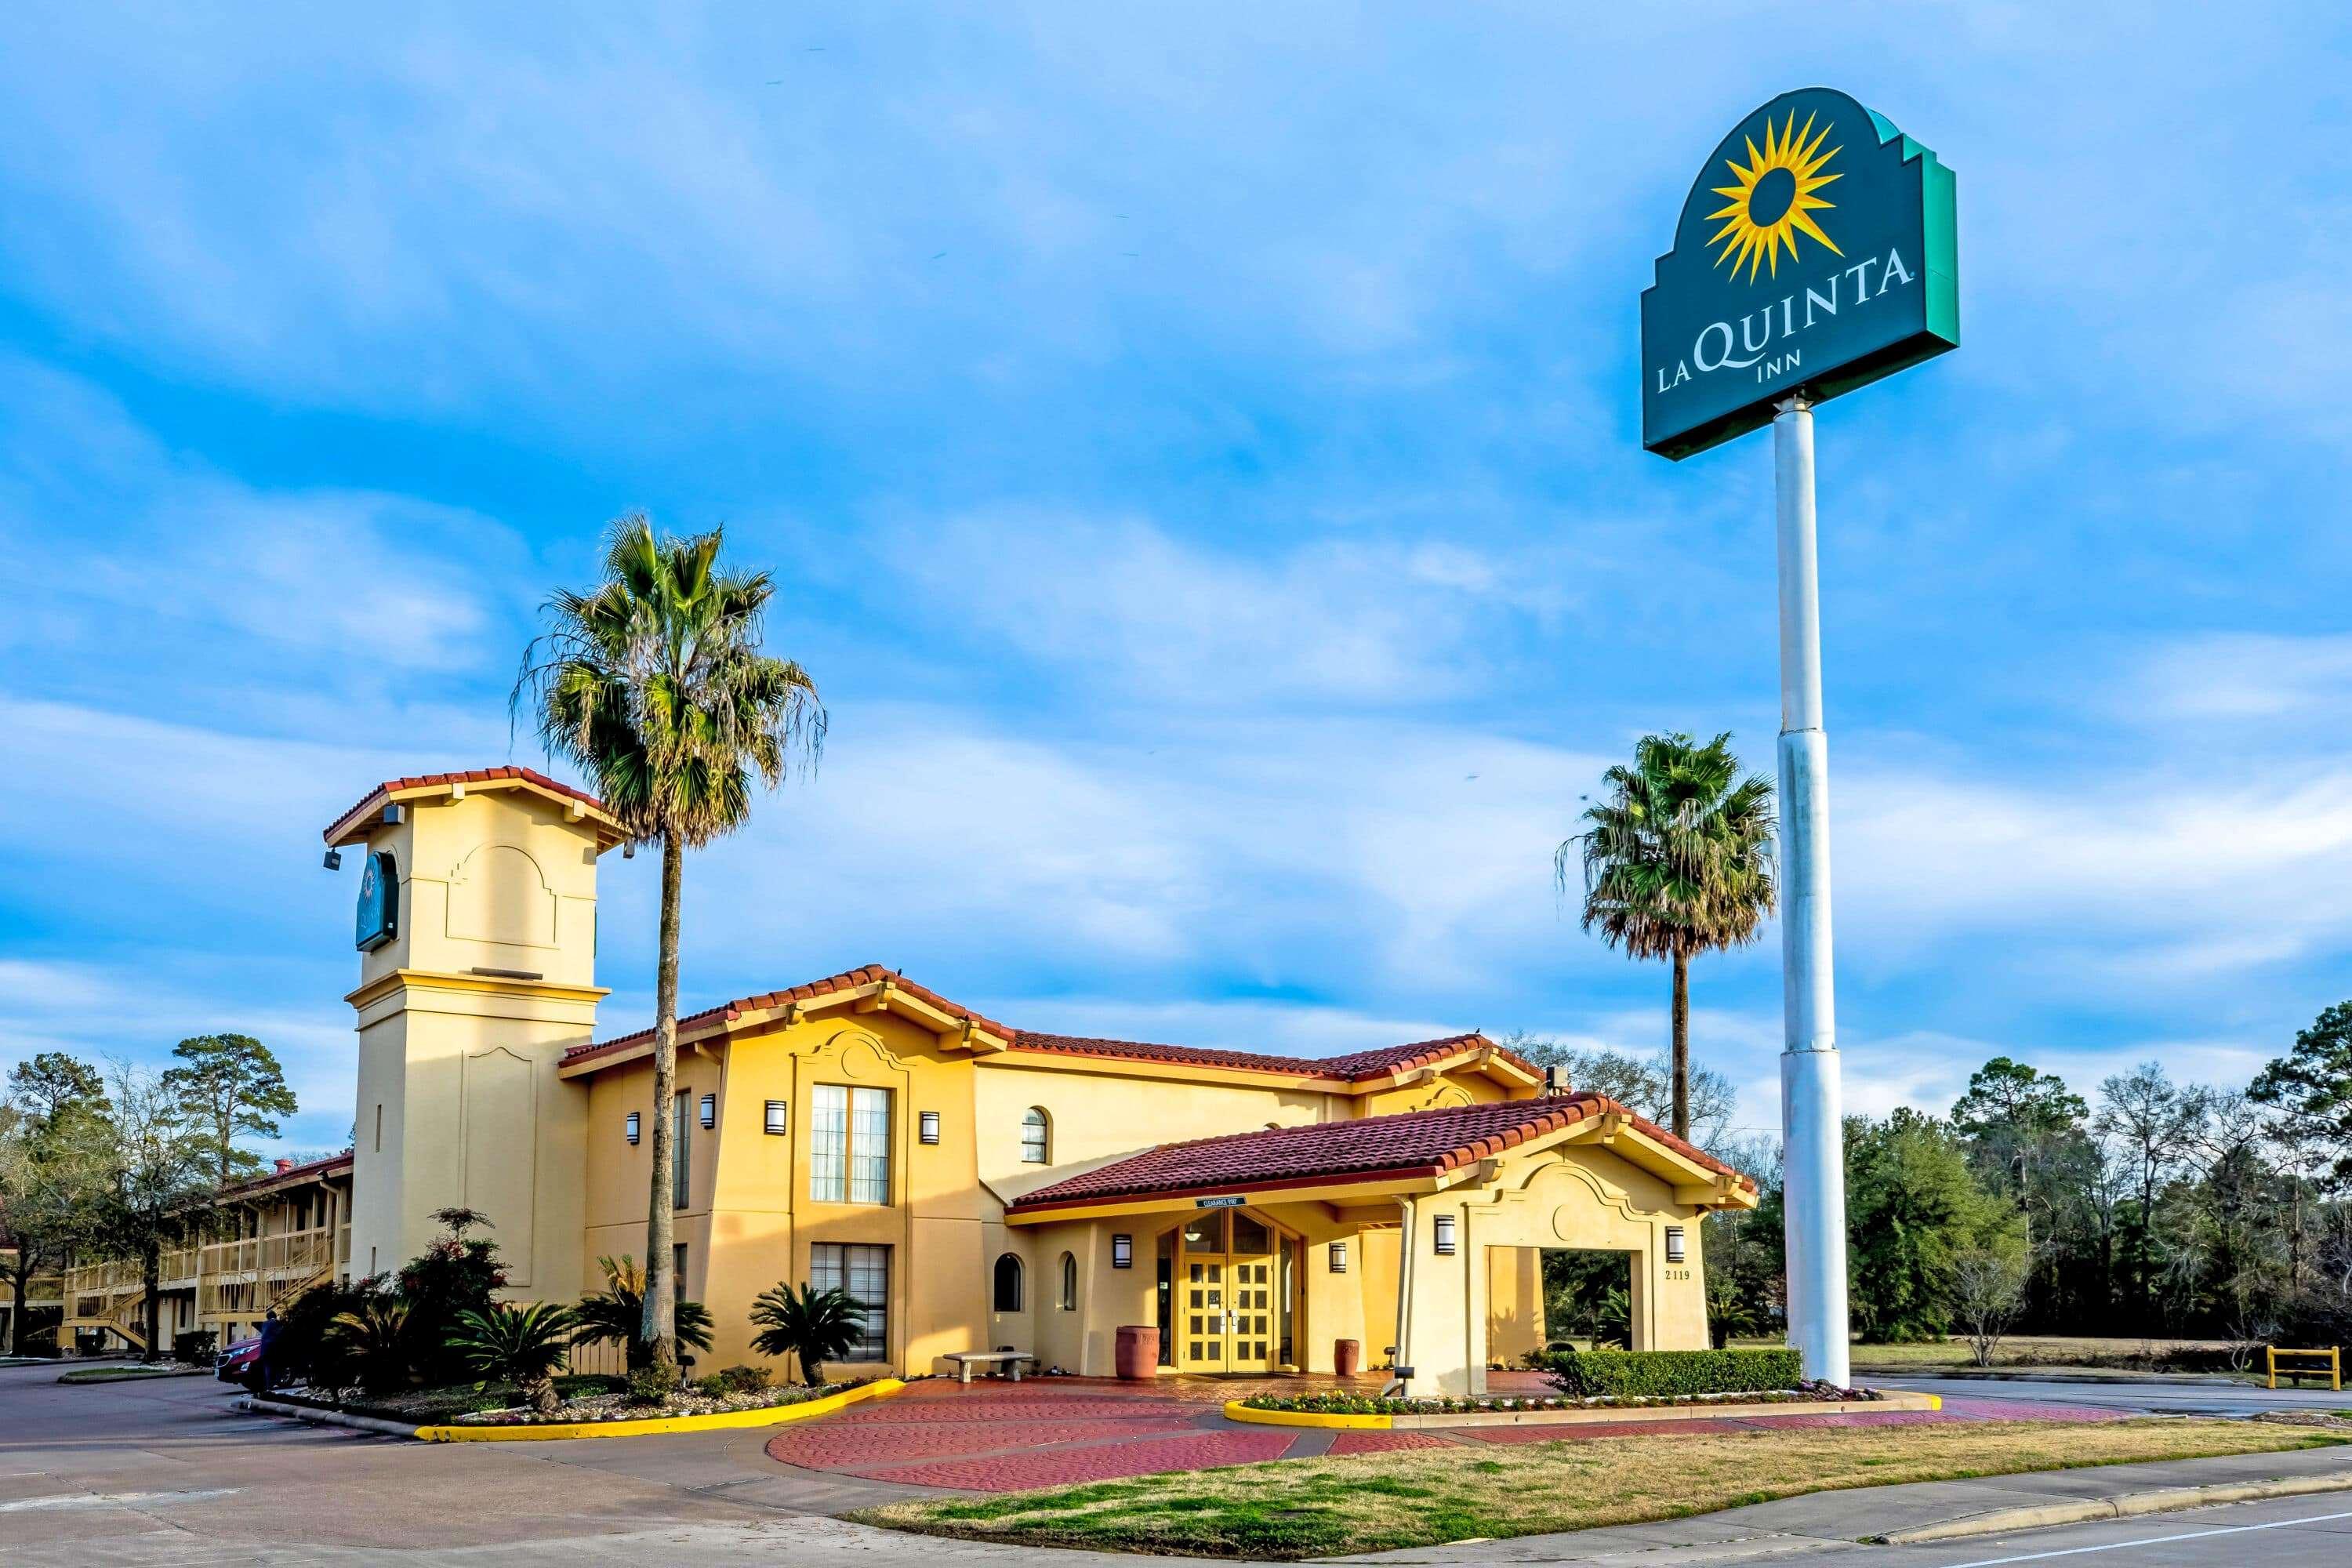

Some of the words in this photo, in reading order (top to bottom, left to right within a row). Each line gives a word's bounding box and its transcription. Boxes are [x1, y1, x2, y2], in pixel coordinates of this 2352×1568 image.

[1657, 359, 1693, 394] LA
[1693, 247, 1915, 372] QUINTA
[1757, 349, 1801, 383] INN
[1665, 1270, 1690, 1279] 2119
